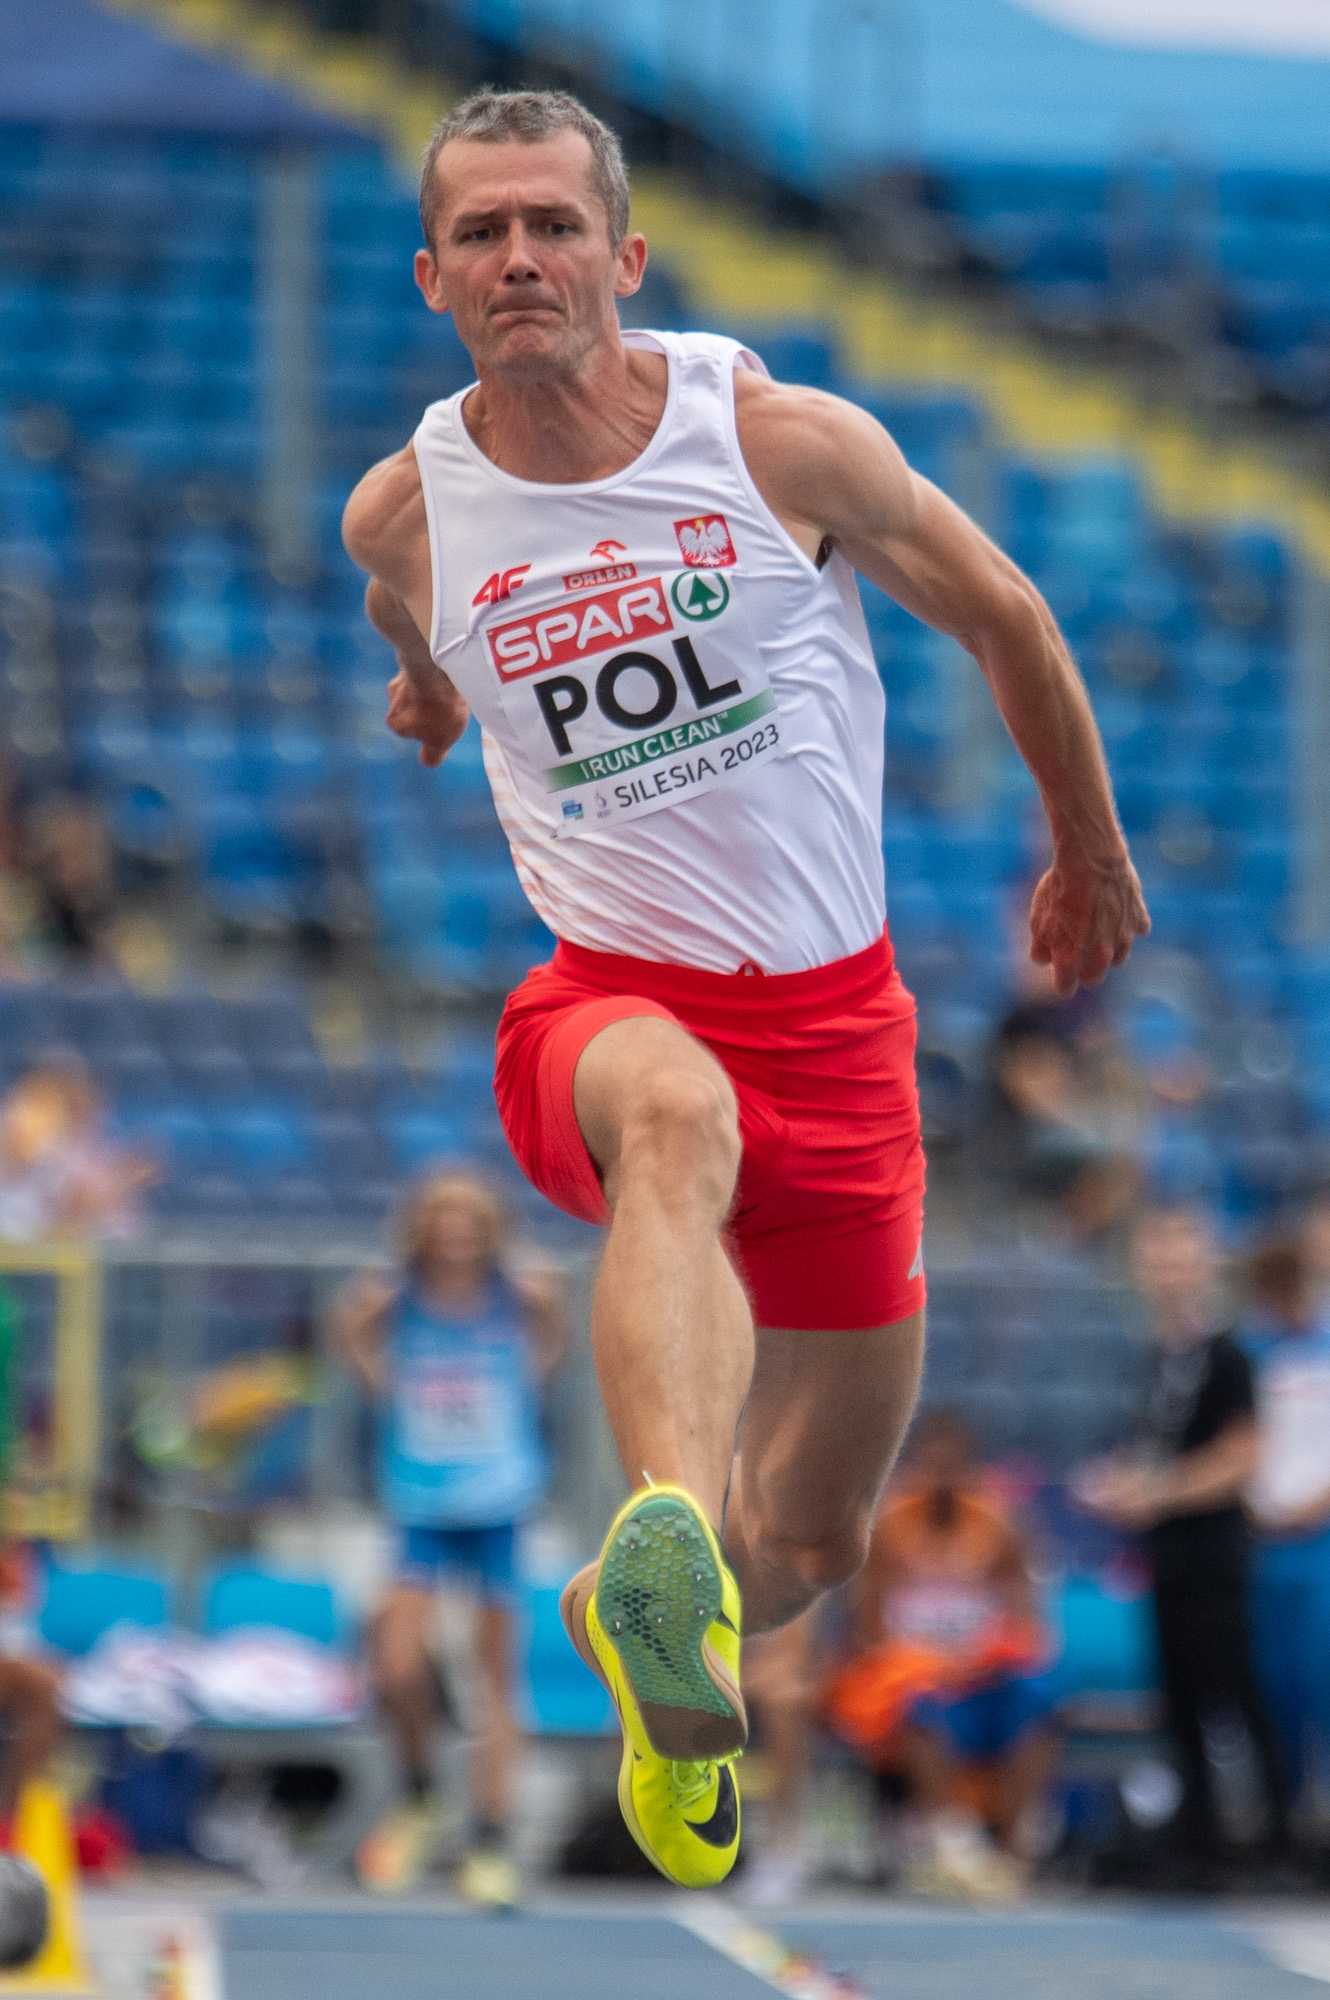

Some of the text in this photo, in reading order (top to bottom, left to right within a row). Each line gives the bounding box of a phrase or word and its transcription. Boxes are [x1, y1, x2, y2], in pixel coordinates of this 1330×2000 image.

[472, 563, 532, 608] 4F
[568, 565, 632, 589] ORLEN
[494, 586, 666, 674] SPAR
[533, 635, 743, 758] POL
[580, 763, 590, 780] I
[589, 749, 641, 778] RUN
[614, 724, 779, 808] SILESIA 2023
